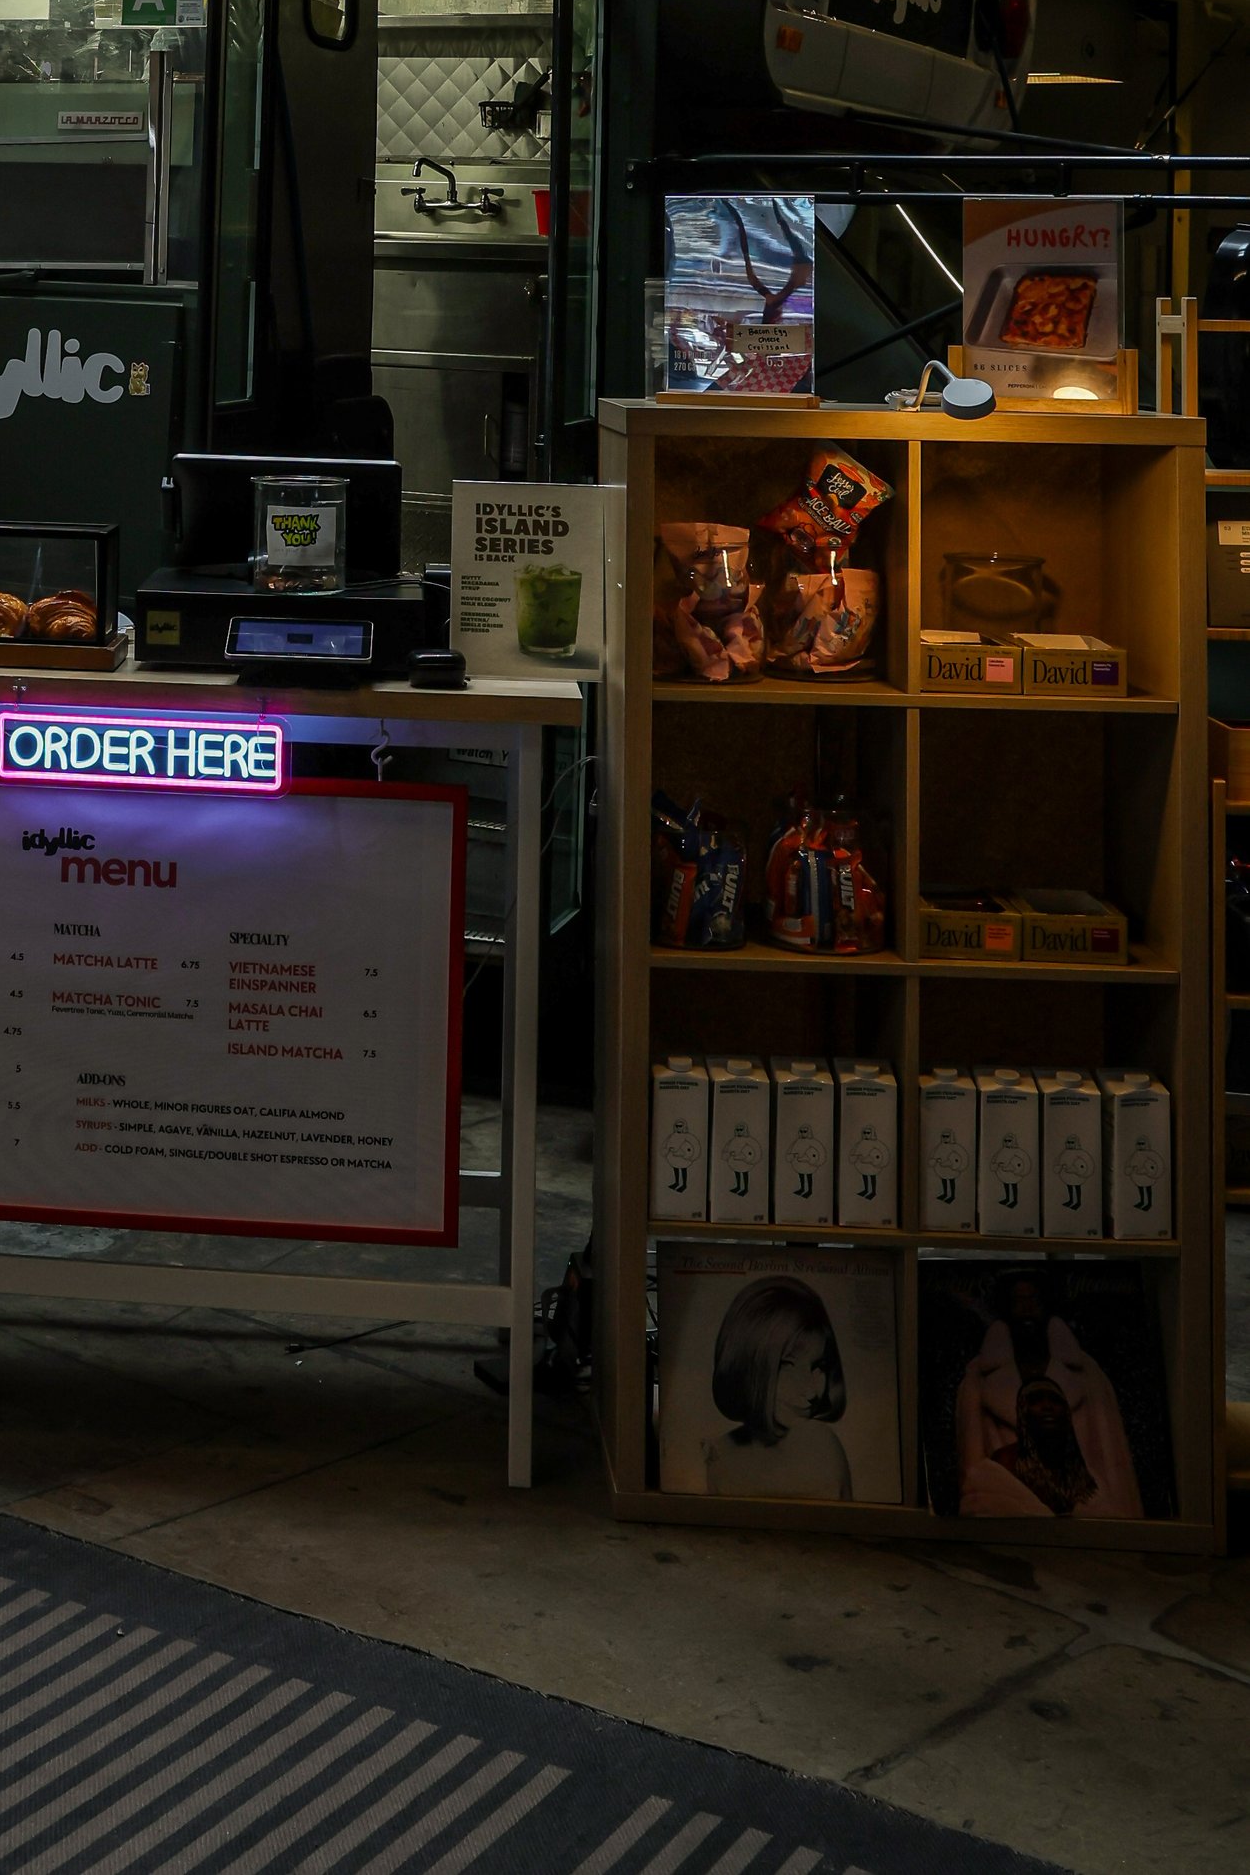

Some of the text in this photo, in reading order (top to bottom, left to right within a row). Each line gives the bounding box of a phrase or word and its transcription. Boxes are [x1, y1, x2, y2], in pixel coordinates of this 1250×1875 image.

[1007, 225, 1111, 248] HUNGRY?
[748, 328, 771, 336] Bacon
[773, 328, 788, 337] Egg
[990, 364, 1028, 372] SLICES
[475, 503, 562, 518] IDYLLIC'S
[272, 514, 321, 533] THANK
[475, 517, 570, 537] ISLAND
[281, 531, 317, 547] YOU!
[474, 536, 554, 555] SERIES
[474, 554, 515, 563] IS BACK
[927, 655, 984, 681] David
[1032, 659, 1088, 685] David
[9, 726, 278, 778] ORDER HERE
[22, 828, 95, 856] idyllic
[61, 855, 178, 888] menu
[665, 869, 685, 920] BUILT
[722, 864, 740, 914] BUILT
[838, 864, 855, 911] BUILT
[54, 923, 101, 937] MATCHA
[926, 922, 983, 948] David
[229, 932, 290, 946] SPECIALTY
[1031, 927, 1088, 951] David
[10, 953, 24, 961] 4.5
[53, 953, 158, 970] MATCHA LATTE
[181, 961, 200, 969] 6.75
[229, 962, 316, 976] VIETNAMESE
[365, 968, 378, 977] 7.5
[229, 978, 316, 993] EINSPANNER
[10, 990, 23, 998] 4.5
[52, 991, 161, 1009] MATCHA TONIC
[186, 999, 199, 1008] 7.5
[228, 1002, 323, 1018] MASALA CHAI
[363, 1010, 377, 1018] 6.5
[3, 1028, 22, 1036] 4.75
[228, 1019, 269, 1032] LATTE
[227, 1043, 343, 1060] ISLAND MATCHA
[363, 1050, 376, 1058] 7.5
[15, 1065, 22, 1073] 5
[77, 1073, 126, 1086] ADD-ONS
[8, 1101, 21, 1110] 5.5
[76, 1097, 345, 1120] MILKS WHOLE, MINOR FIGURES OAT, CALIFIA ALMOND
[75, 1120, 393, 1146] SYRUPS SIMPLE, AGAVE, VANILLA, HAZELNUT, LAVENDER, HONEY
[75, 1143, 392, 1170] ADD COLD FOAM, SINGLE/DOUBLE SHOT ESPRESSO OR MATCHA
